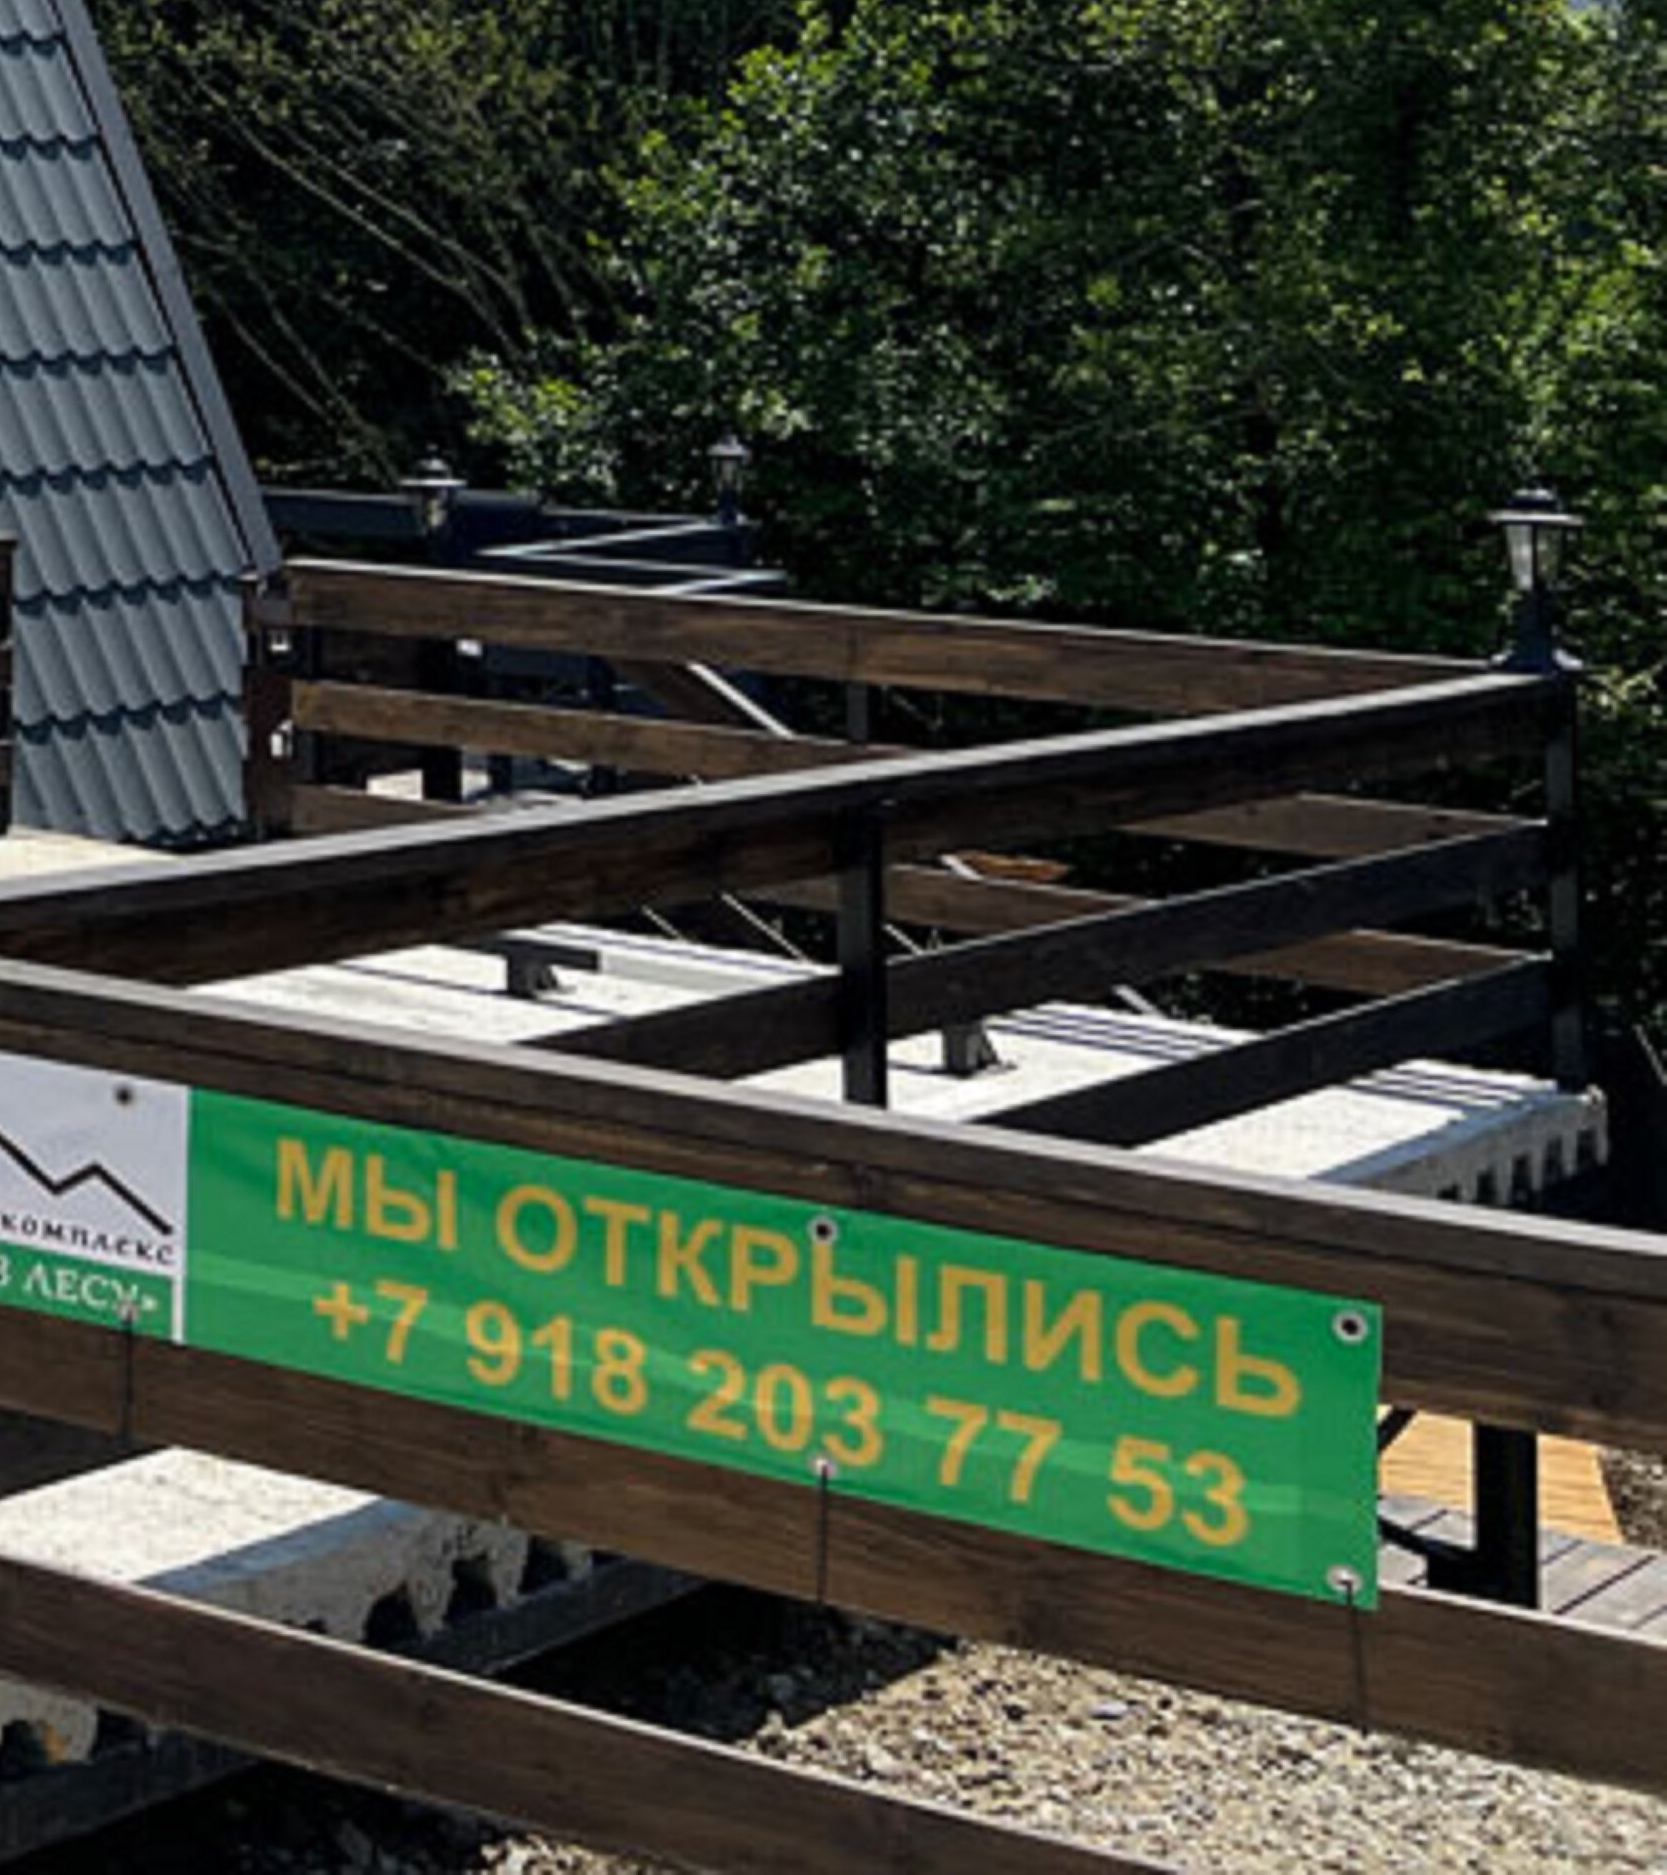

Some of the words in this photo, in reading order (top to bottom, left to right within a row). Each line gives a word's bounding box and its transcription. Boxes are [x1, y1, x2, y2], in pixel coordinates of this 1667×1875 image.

[0, 1211, 179, 1267] комплекс
[276, 1138, 458, 1251] МЫ
[495, 1184, 1303, 1417] ОТКРЫЛИСЬ
[313, 1281, 429, 1364] +7
[465, 1300, 650, 1415] 918
[686, 1349, 885, 1467] 203
[925, 1396, 1062, 1504] 77
[1106, 1434, 1250, 1546] 53
